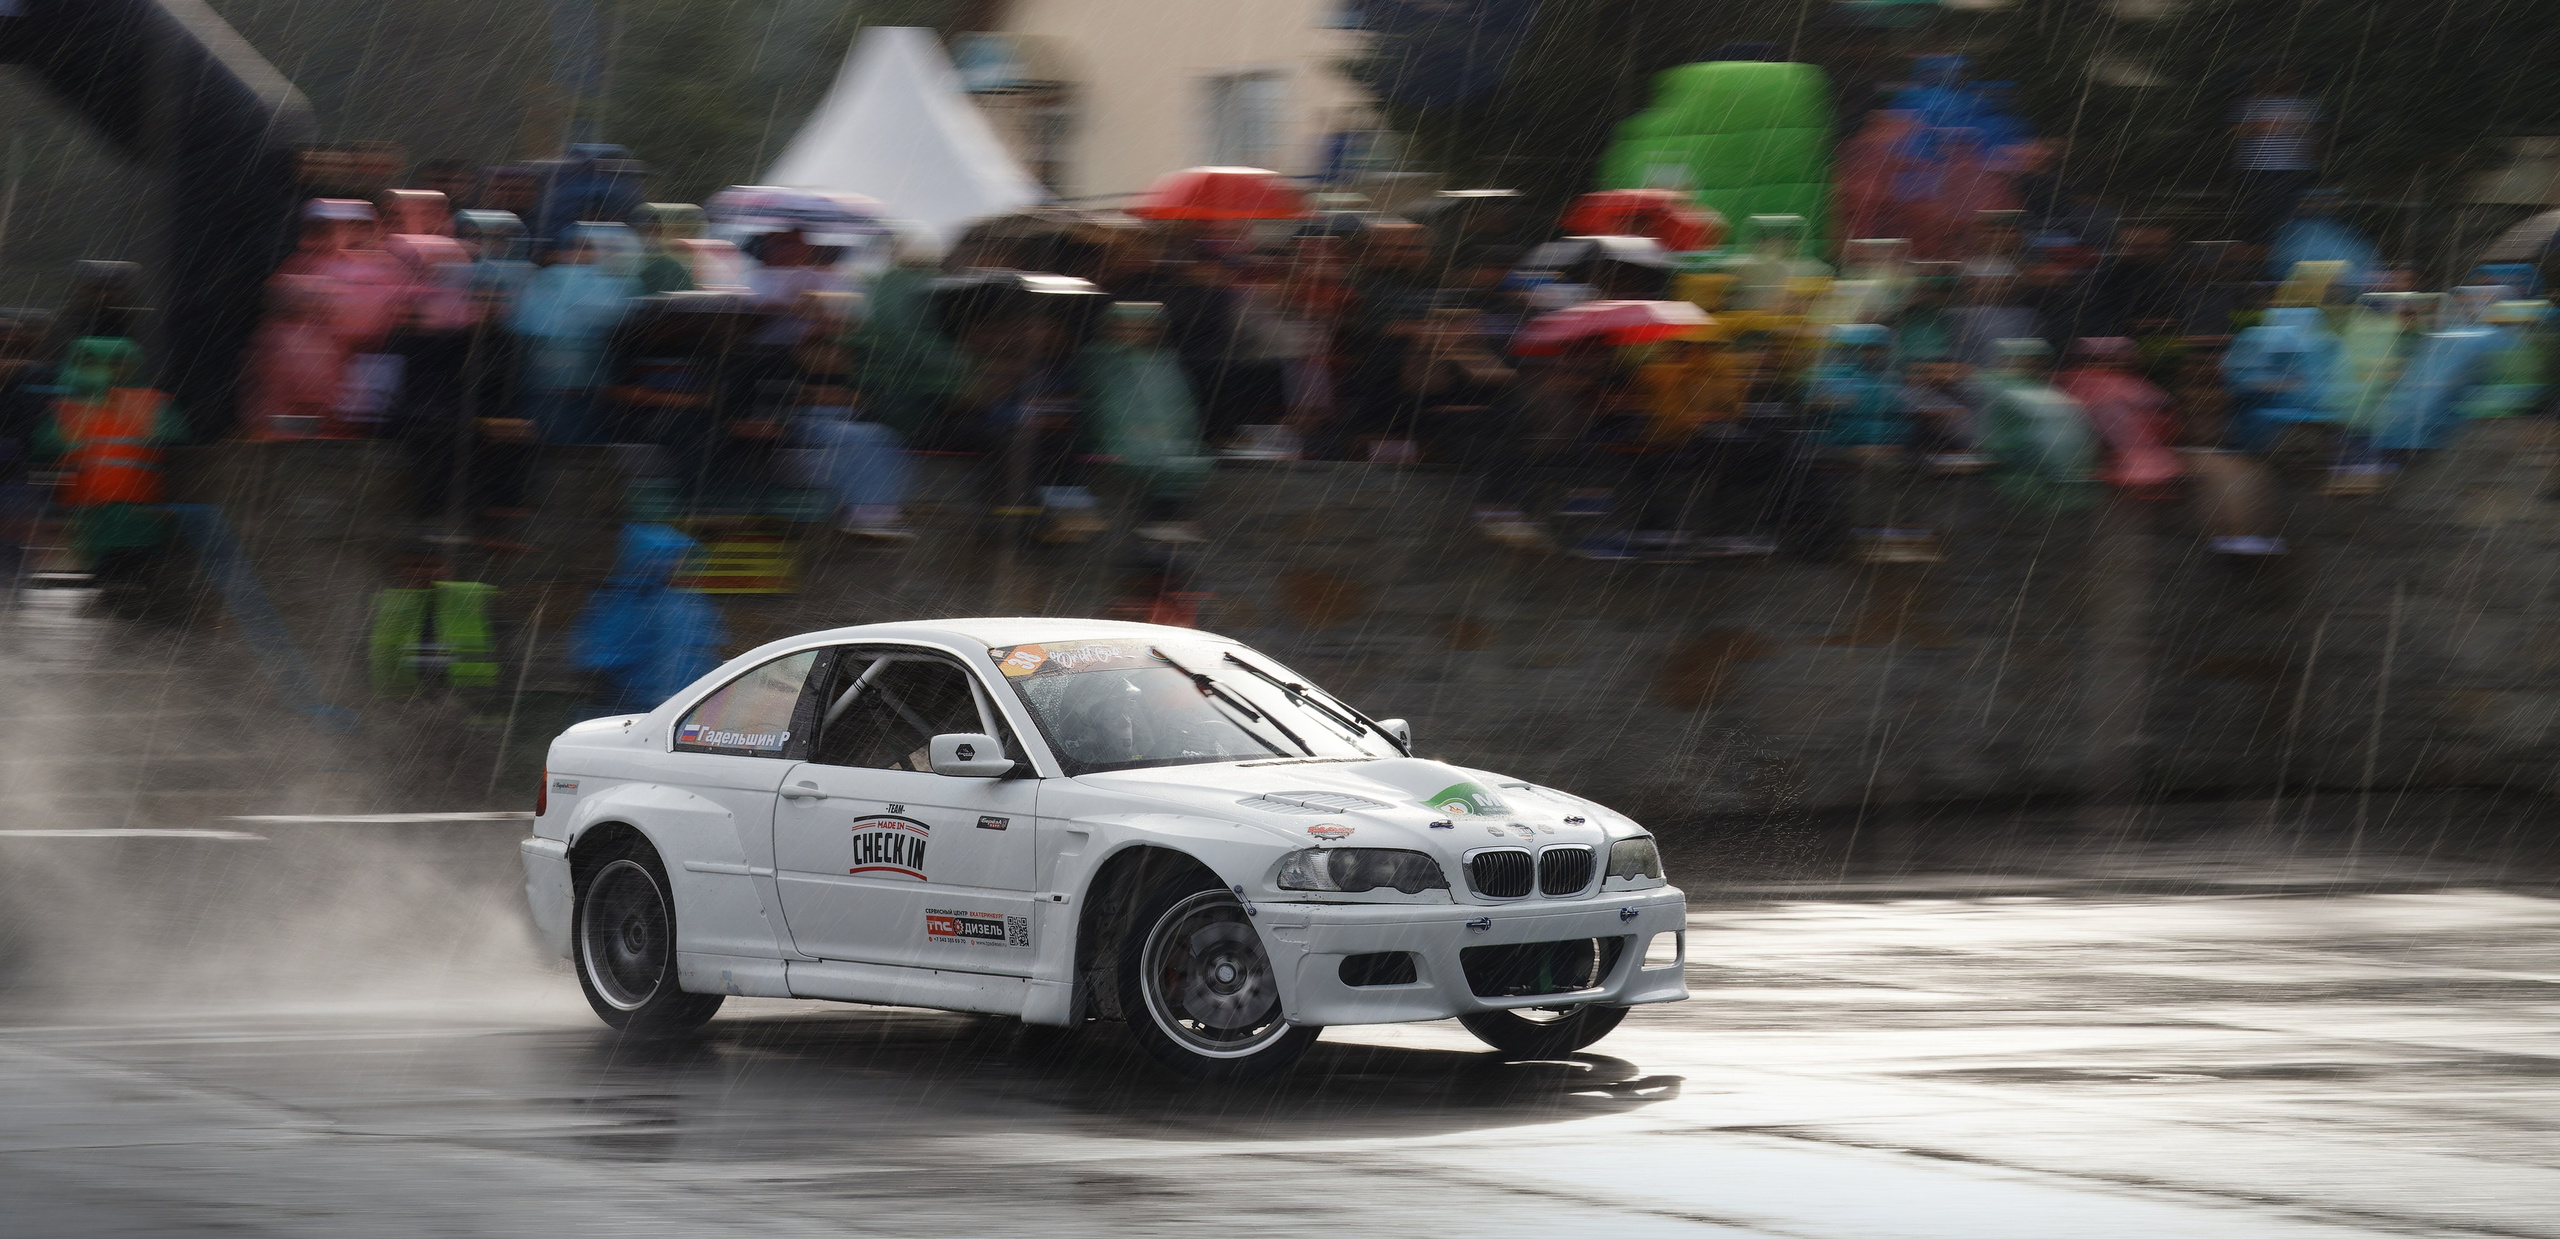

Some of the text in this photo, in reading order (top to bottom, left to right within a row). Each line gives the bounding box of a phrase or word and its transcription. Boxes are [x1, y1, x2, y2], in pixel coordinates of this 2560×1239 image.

[1008, 650, 1042, 670] 38
[697, 726, 776, 746] Гадельшин
[877, 821, 905, 830] MADE IN
[853, 832, 926, 871] CHECK IN
[965, 923, 1003, 936] ДИЗЕЛЬ
